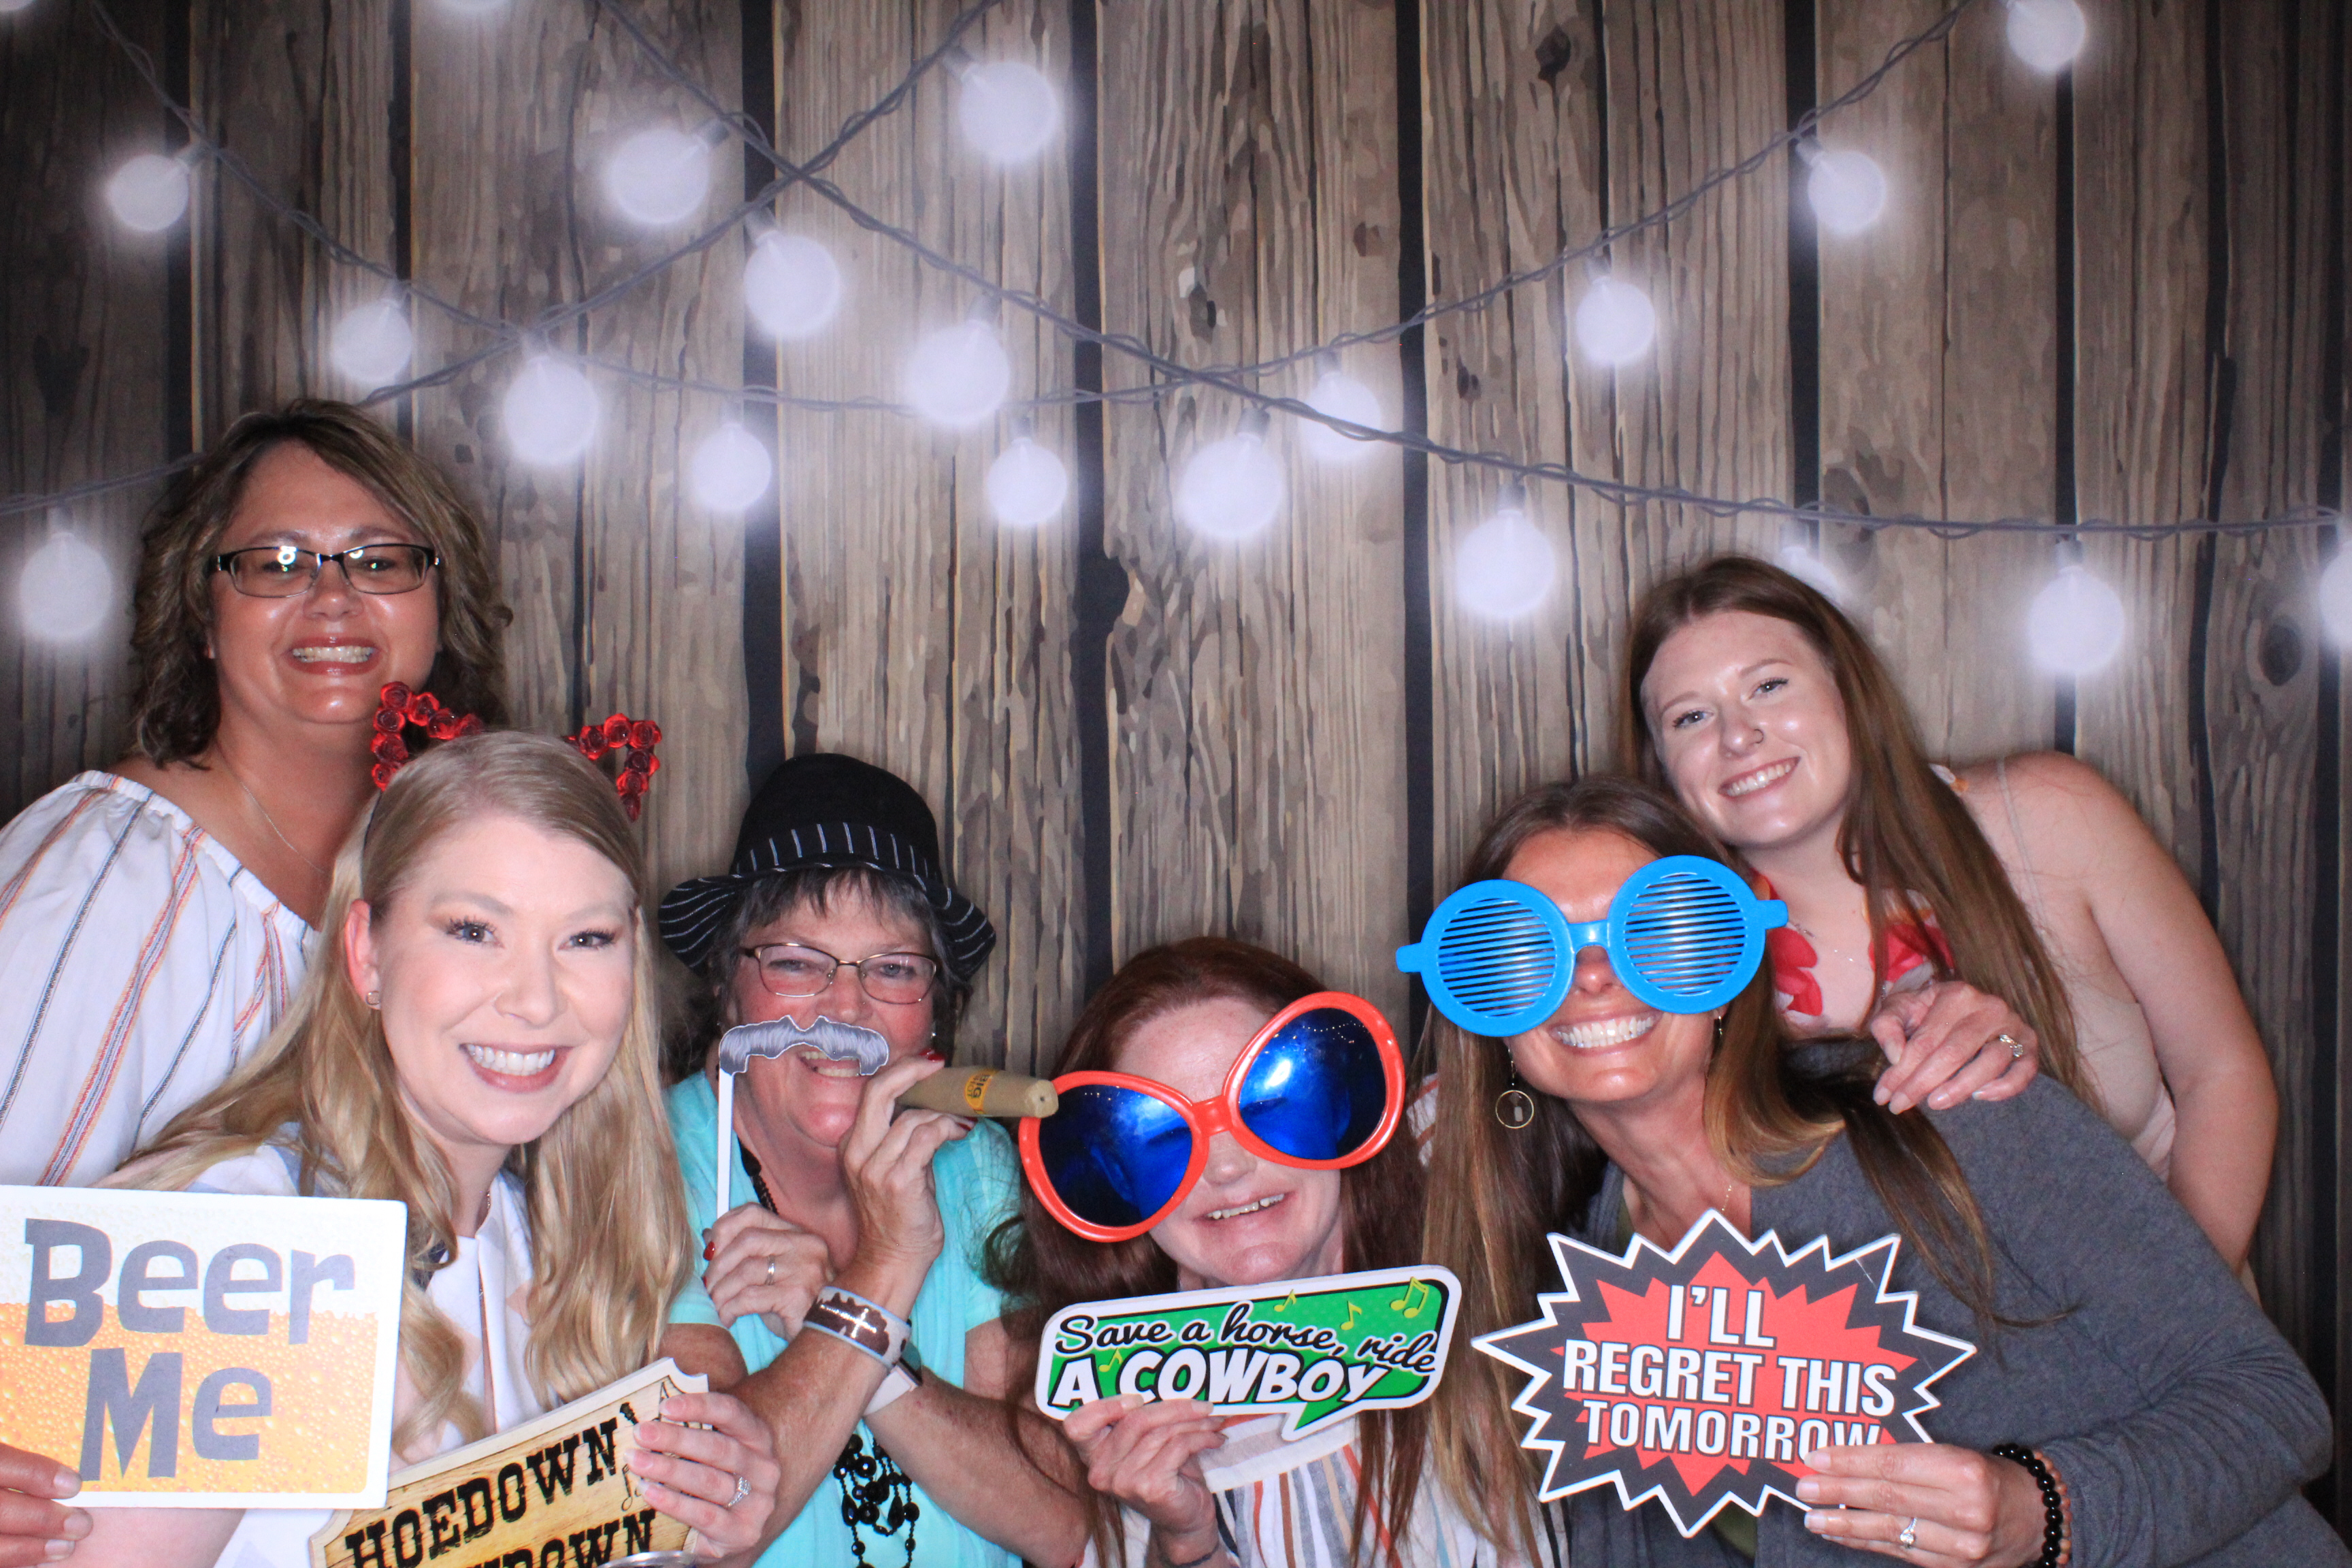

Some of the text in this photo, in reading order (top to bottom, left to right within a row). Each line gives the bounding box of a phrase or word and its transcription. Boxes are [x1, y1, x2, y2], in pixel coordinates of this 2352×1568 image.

[973, 1075, 990, 1098] BIG
[24, 1218, 356, 1348] Beer
[1667, 1284, 1776, 1348] I'LL
[1055, 1302, 1436, 1373] Save a horse, ride
[1049, 1345, 1392, 1407] A COWBOY
[1563, 1339, 1895, 1417] REGRET THIS
[78, 1348, 272, 1482] Me
[1583, 1399, 1880, 1462] TOMORROW
[344, 1416, 619, 1568] HOEDOWN
